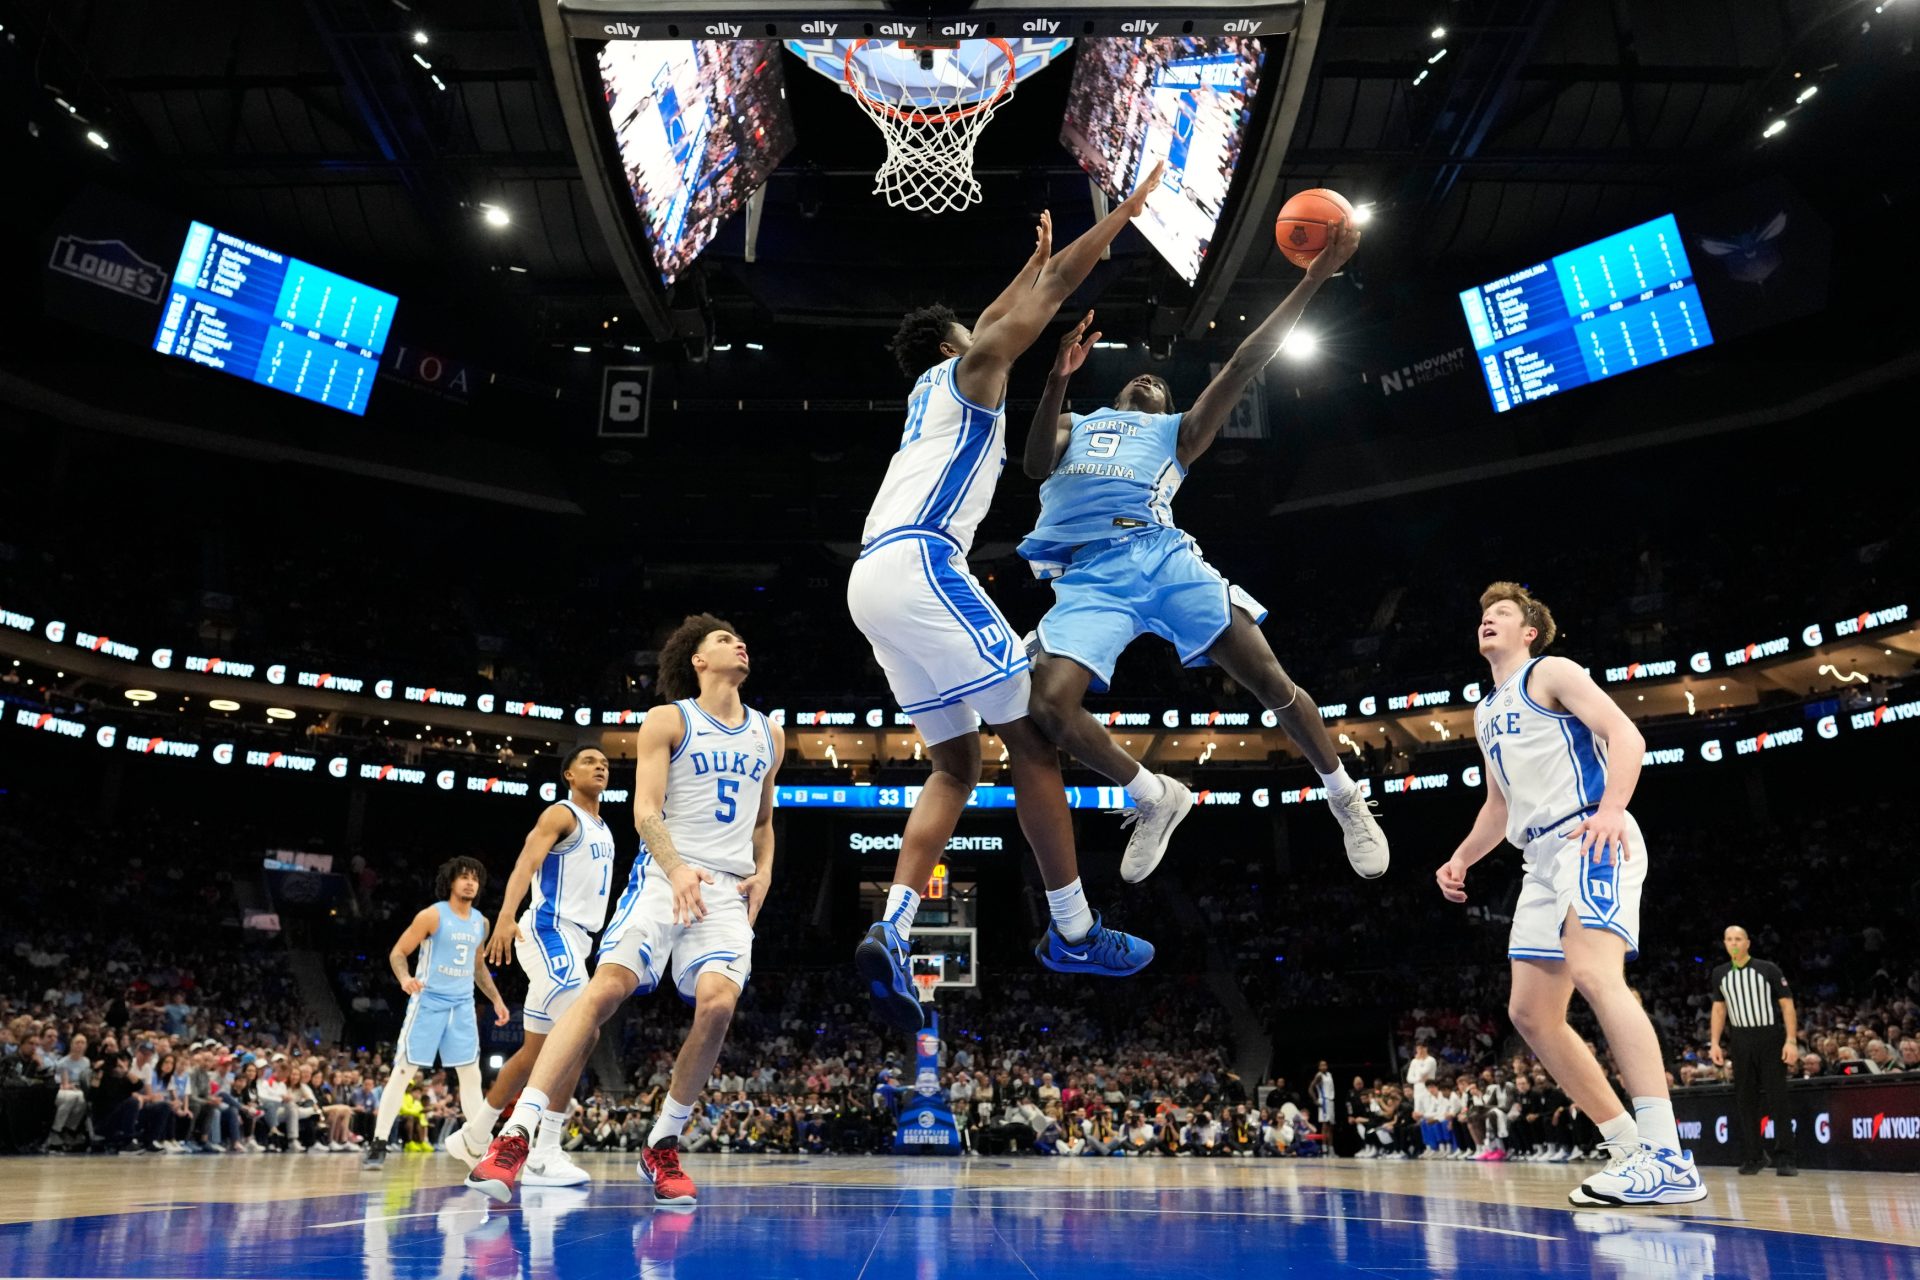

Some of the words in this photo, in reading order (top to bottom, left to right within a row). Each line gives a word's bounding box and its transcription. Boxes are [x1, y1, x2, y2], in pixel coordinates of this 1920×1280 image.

[604, 23, 640, 38] ally
[706, 23, 742, 37] ally
[801, 21, 838, 36] ally
[880, 22, 916, 38] ally
[942, 22, 978, 37] ally
[1023, 19, 1061, 35] ally
[1120, 20, 1159, 35] ally
[1223, 19, 1262, 34] ally
[64, 243, 154, 295] LOWE'S
[1413, 347, 1464, 373] NOVANT
[609, 382, 641, 421] 6
[1084, 420, 1138, 438] NORTH
[1085, 432, 1122, 459] 9
[690, 751, 767, 783] DUKE
[1490, 742, 1511, 786] 7
[715, 778, 740, 824] 5
[879, 789, 899, 805] 33
[599, 864, 609, 896] 1
[453, 944, 468, 965] 3
[903, 1135, 949, 1145] GREATNESS
